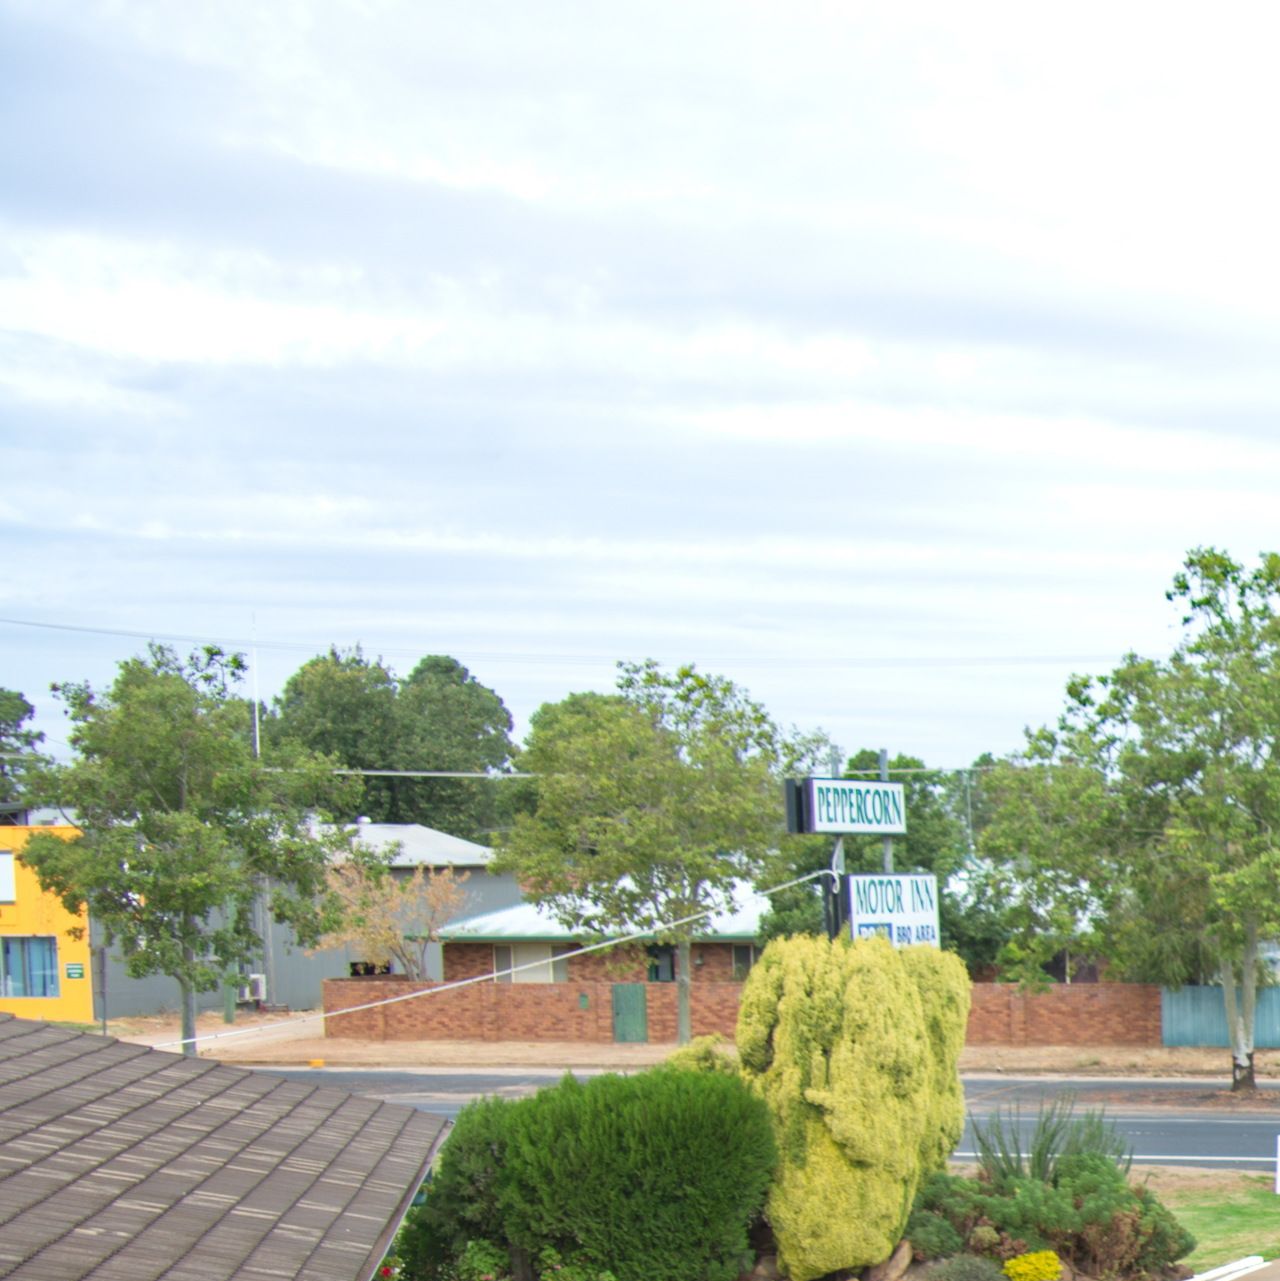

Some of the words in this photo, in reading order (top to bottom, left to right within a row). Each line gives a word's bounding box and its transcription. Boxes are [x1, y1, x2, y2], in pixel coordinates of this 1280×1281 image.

[817, 786, 902, 825] PEPPERCORN
[856, 879, 904, 915] MOTOR
[911, 879, 934, 913] INN
[896, 926, 912, 944] BBQ
[915, 925, 936, 940] AREA
